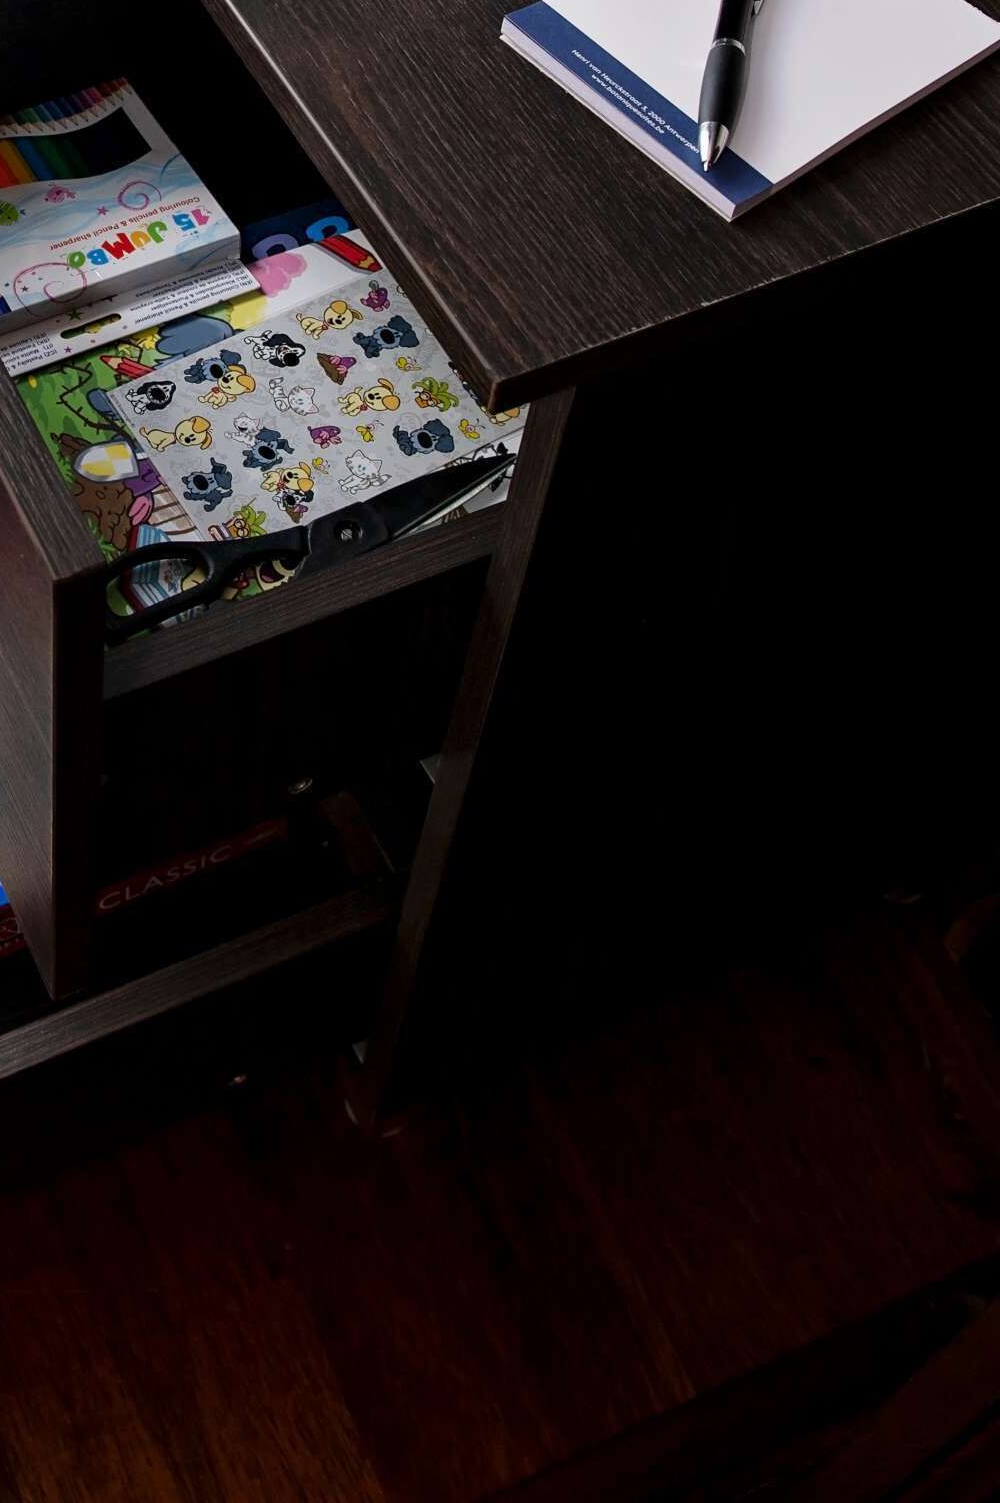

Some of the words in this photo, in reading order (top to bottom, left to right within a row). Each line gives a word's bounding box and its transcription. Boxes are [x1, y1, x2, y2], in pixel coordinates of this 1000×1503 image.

[571, 49, 590, 65] Henri
[589, 62, 601, 74] van
[648, 111, 665, 126] 2000
[664, 124, 700, 154] Antwerpen
[591, 74, 664, 135] www.botaniquesuites.be
[129, 210, 160, 224] pencils
[160, 196, 201, 215] Colouring
[95, 224, 120, 237] Pencil
[172, 208, 211, 232] 15
[50, 231, 93, 251] sharpener
[67, 220, 168, 269] JUMBO
[99, 845, 231, 910] CLASSIC
